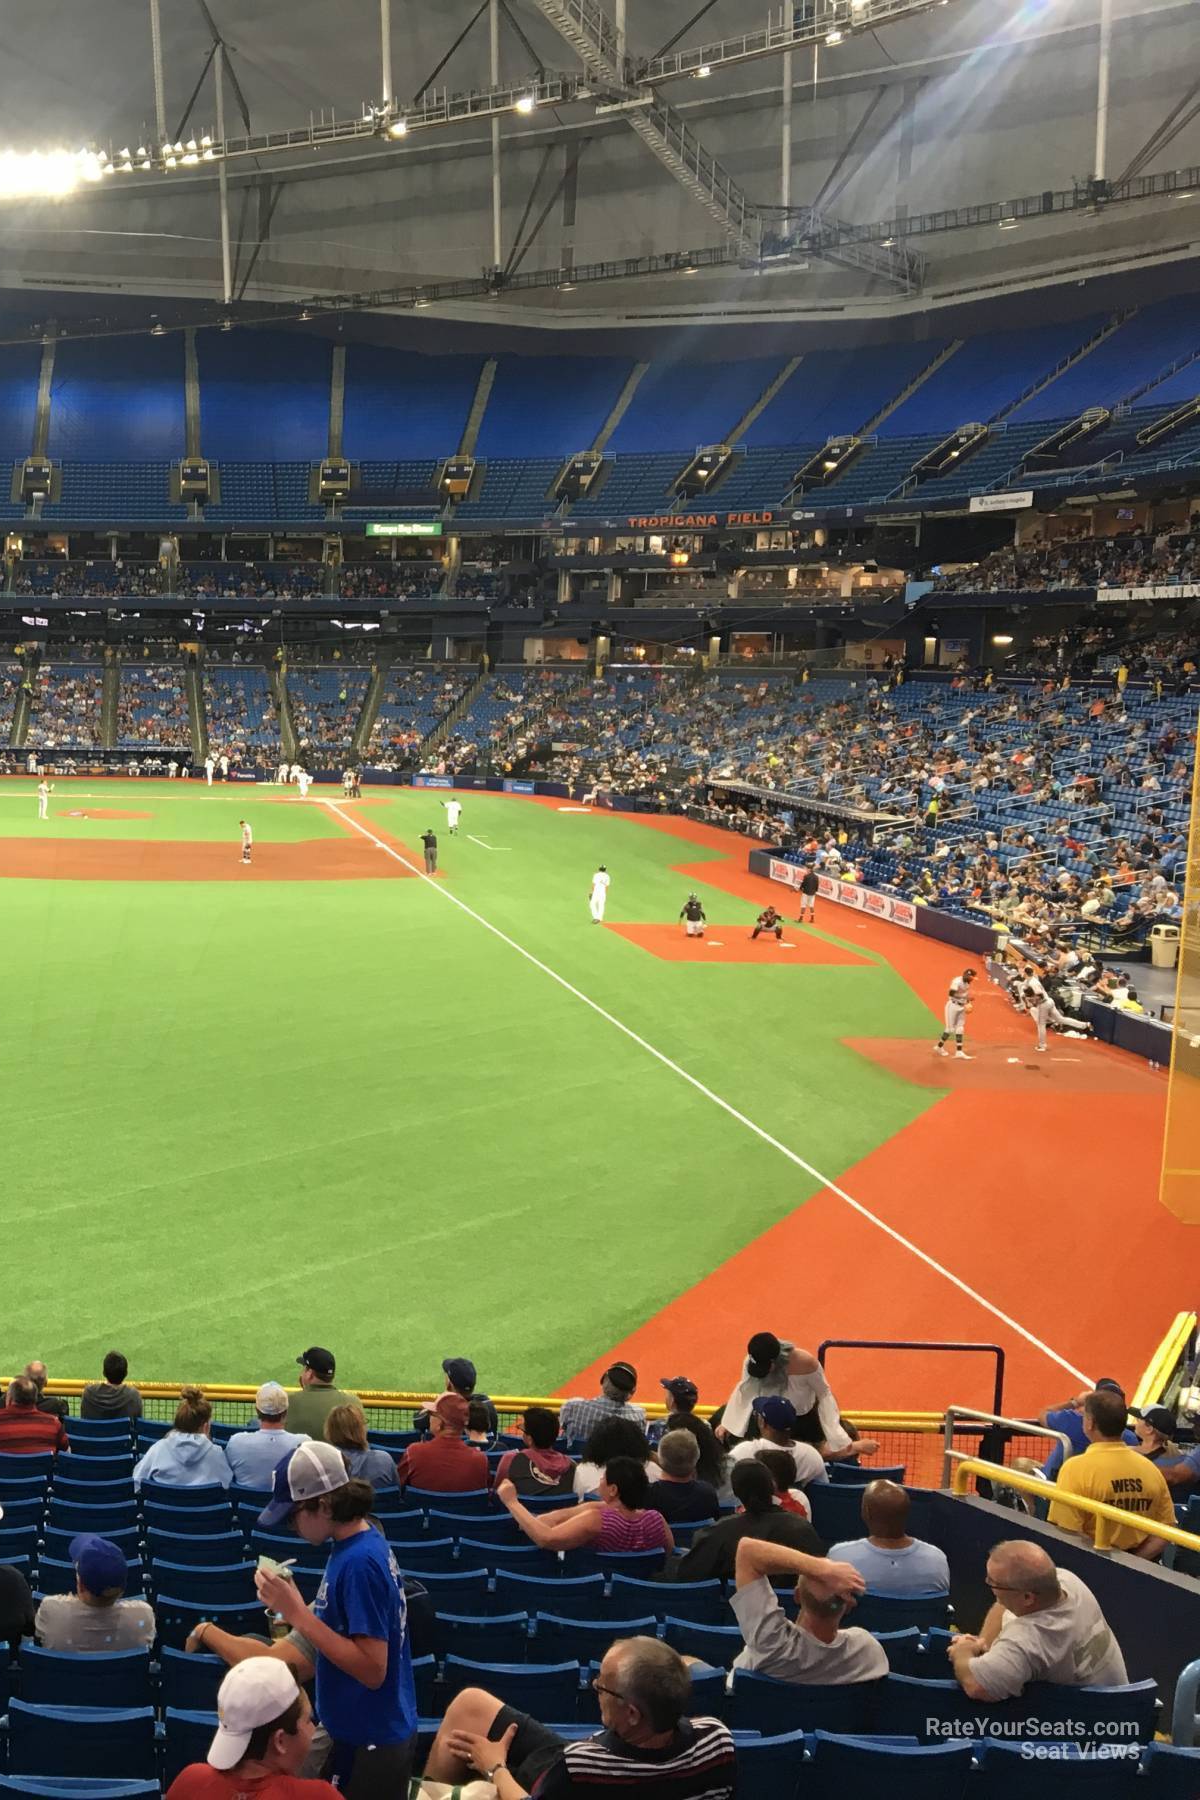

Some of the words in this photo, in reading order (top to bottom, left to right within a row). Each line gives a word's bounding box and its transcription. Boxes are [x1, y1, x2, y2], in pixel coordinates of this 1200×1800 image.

[628, 514, 717, 528] TROPICANA
[727, 512, 773, 525] FIELD
[1111, 1478, 1143, 1494] WESS
